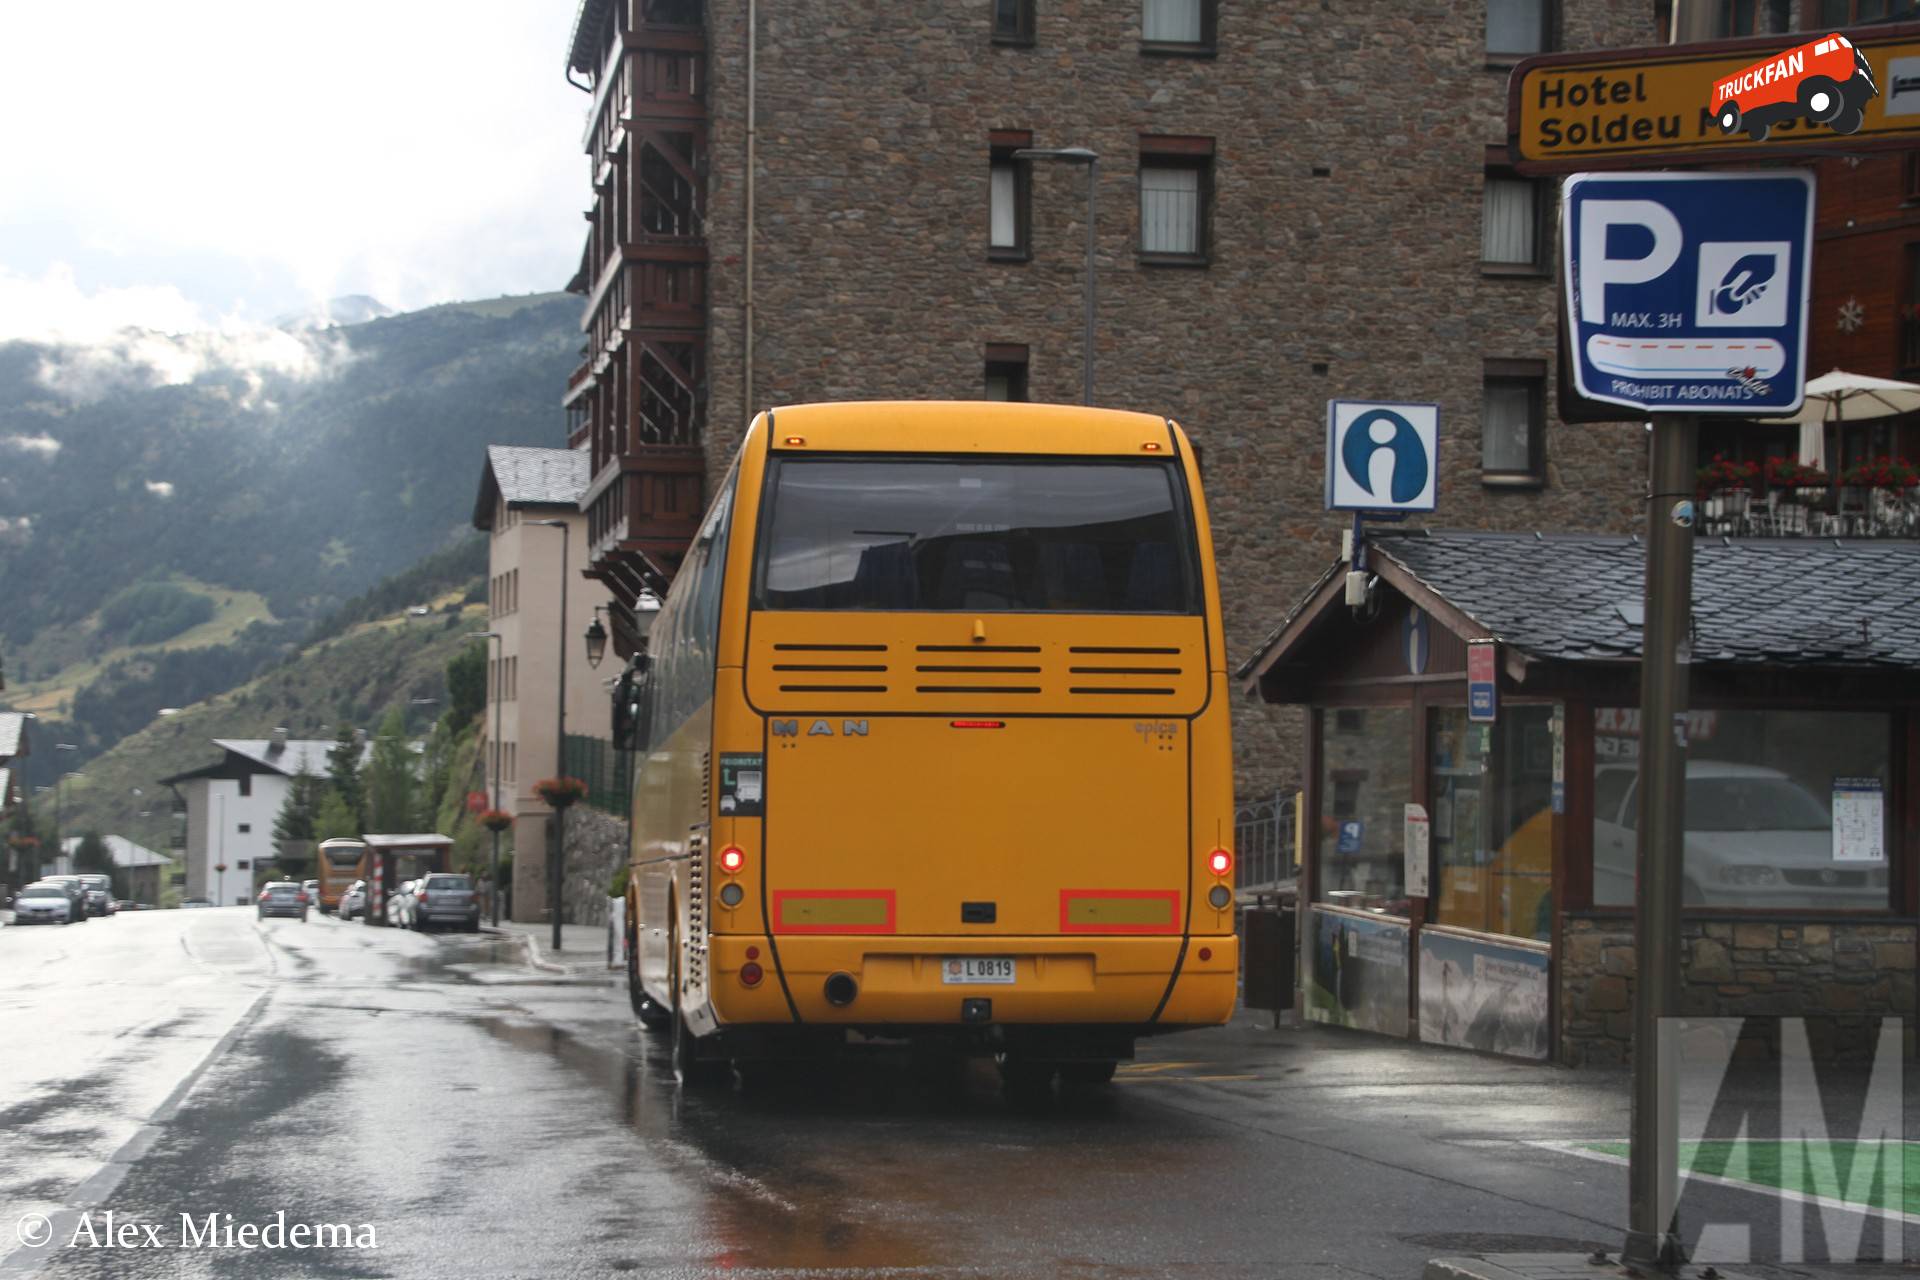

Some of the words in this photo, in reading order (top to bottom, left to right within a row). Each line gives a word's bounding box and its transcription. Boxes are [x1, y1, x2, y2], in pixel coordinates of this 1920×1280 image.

[1538, 73, 1647, 110] Hotel
[1539, 113, 1681, 149] Soldeu
[1580, 199, 1684, 326] P
[1611, 312, 1654, 328] MAX.
[1657, 313, 1682, 328] 3H
[1611, 379, 1676, 399] PROHIBIT
[1676, 385, 1754, 400] ABONATS
[772, 719, 869, 737] MAN
